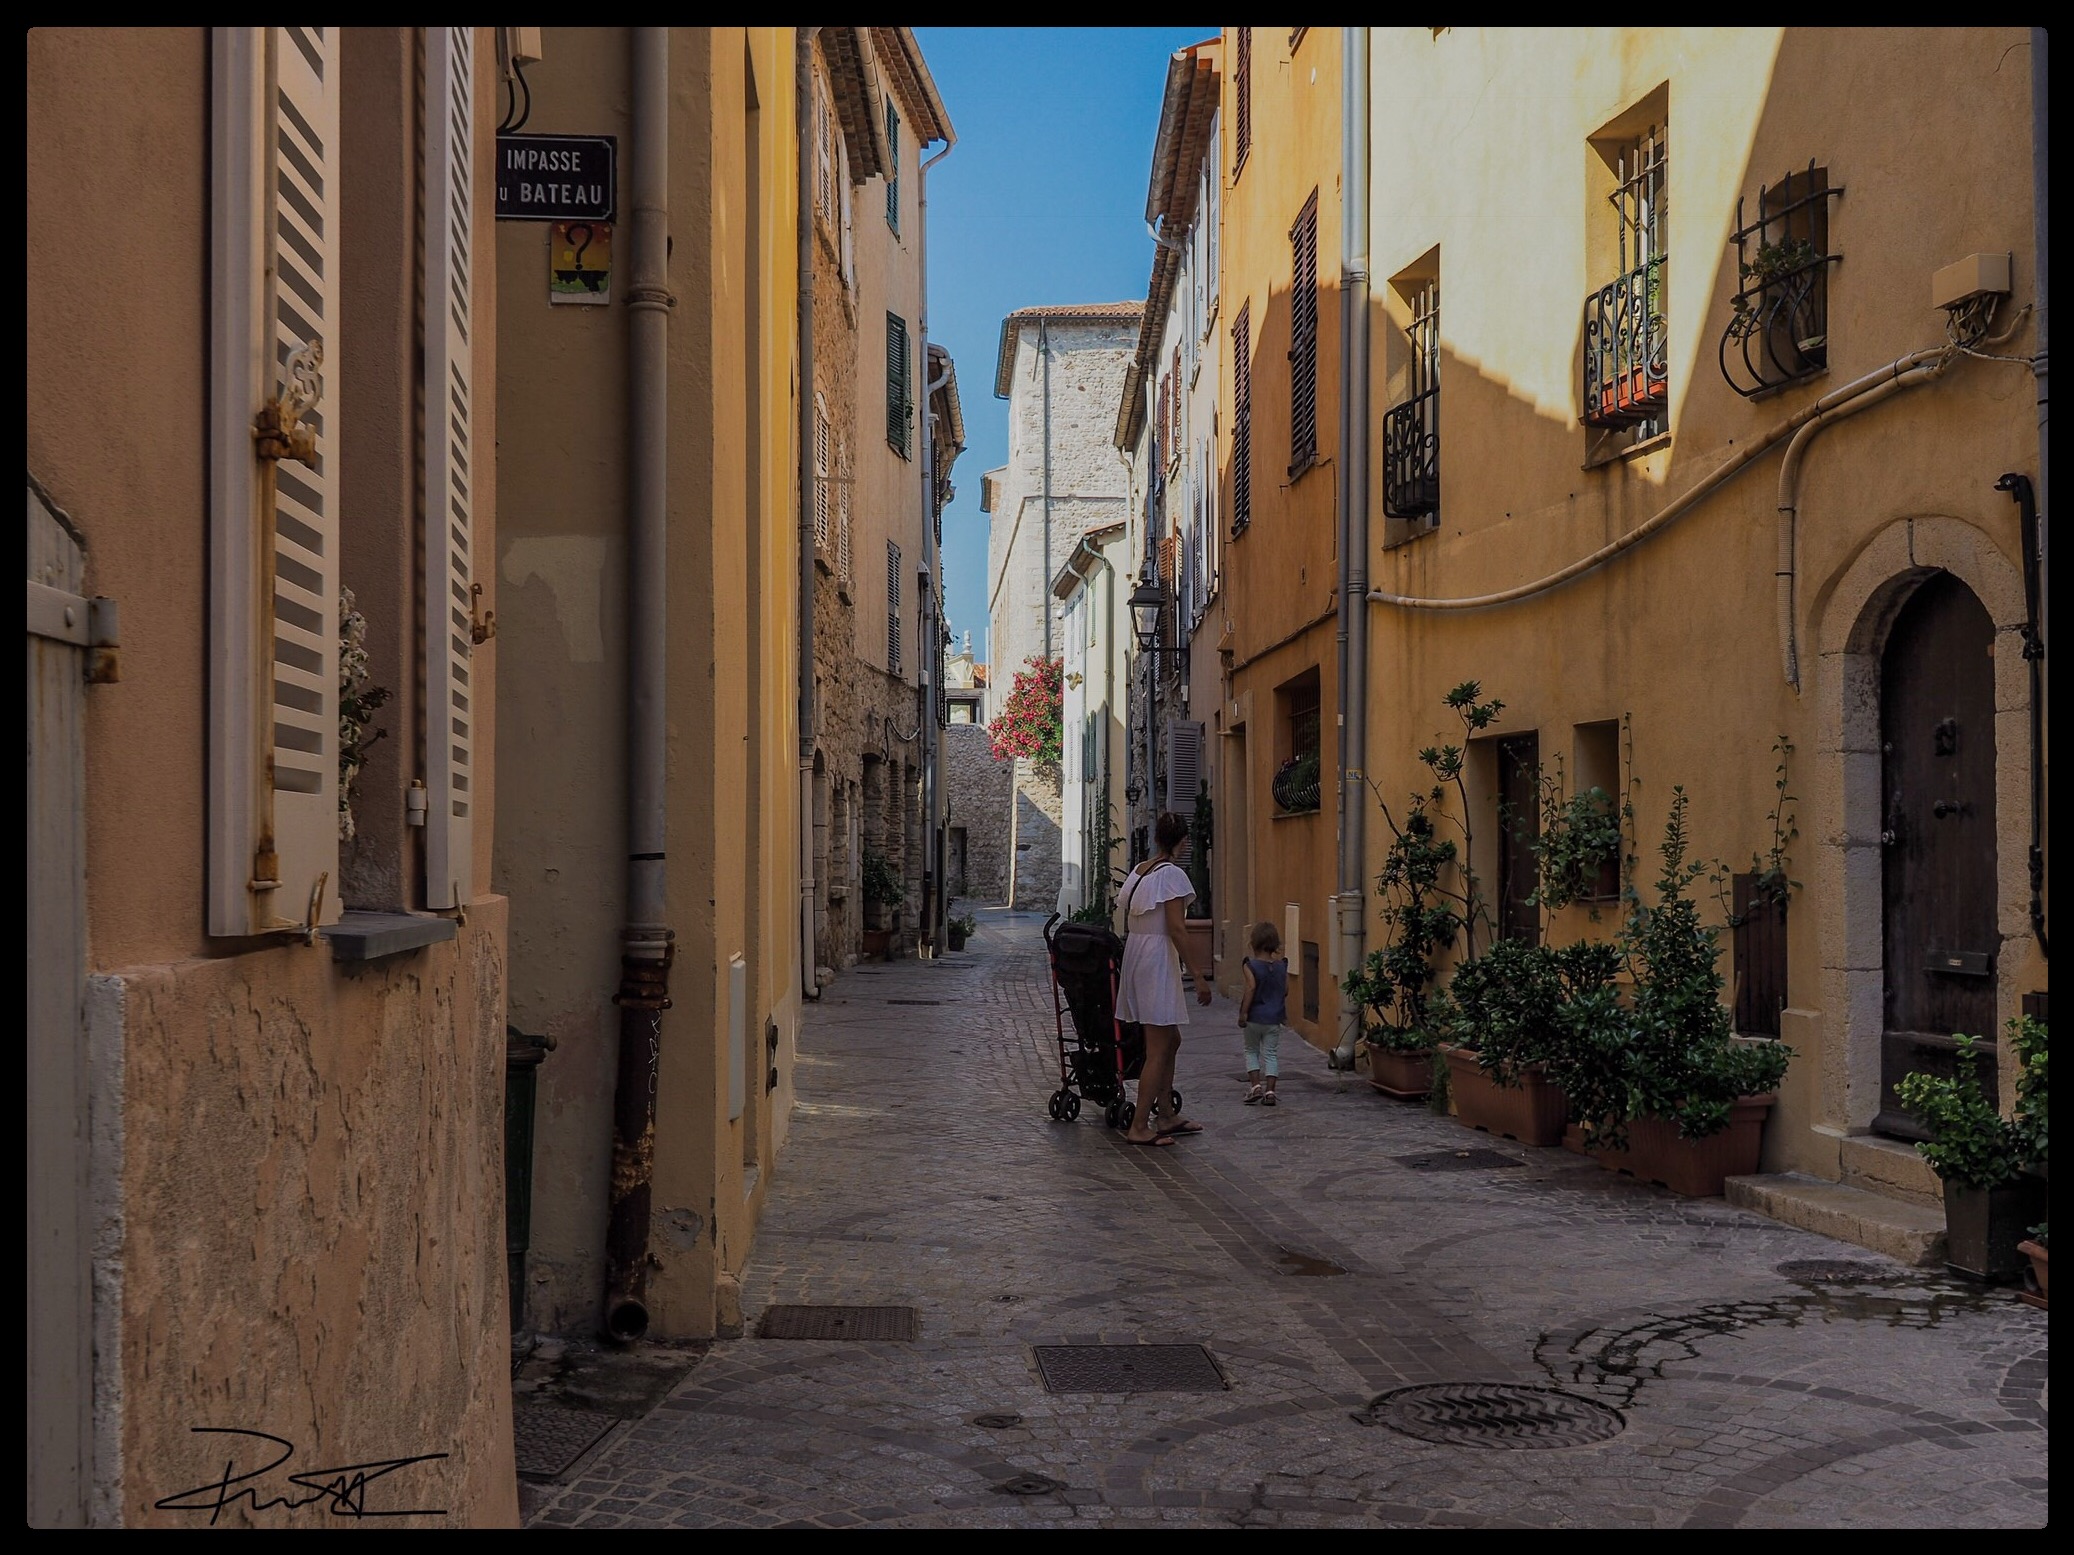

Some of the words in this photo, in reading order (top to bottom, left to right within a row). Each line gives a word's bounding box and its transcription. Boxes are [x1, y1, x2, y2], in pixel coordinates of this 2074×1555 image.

[507, 149, 581, 172] IMPASSE
[499, 186, 508, 202] u
[520, 183, 602, 205] BATEAU
